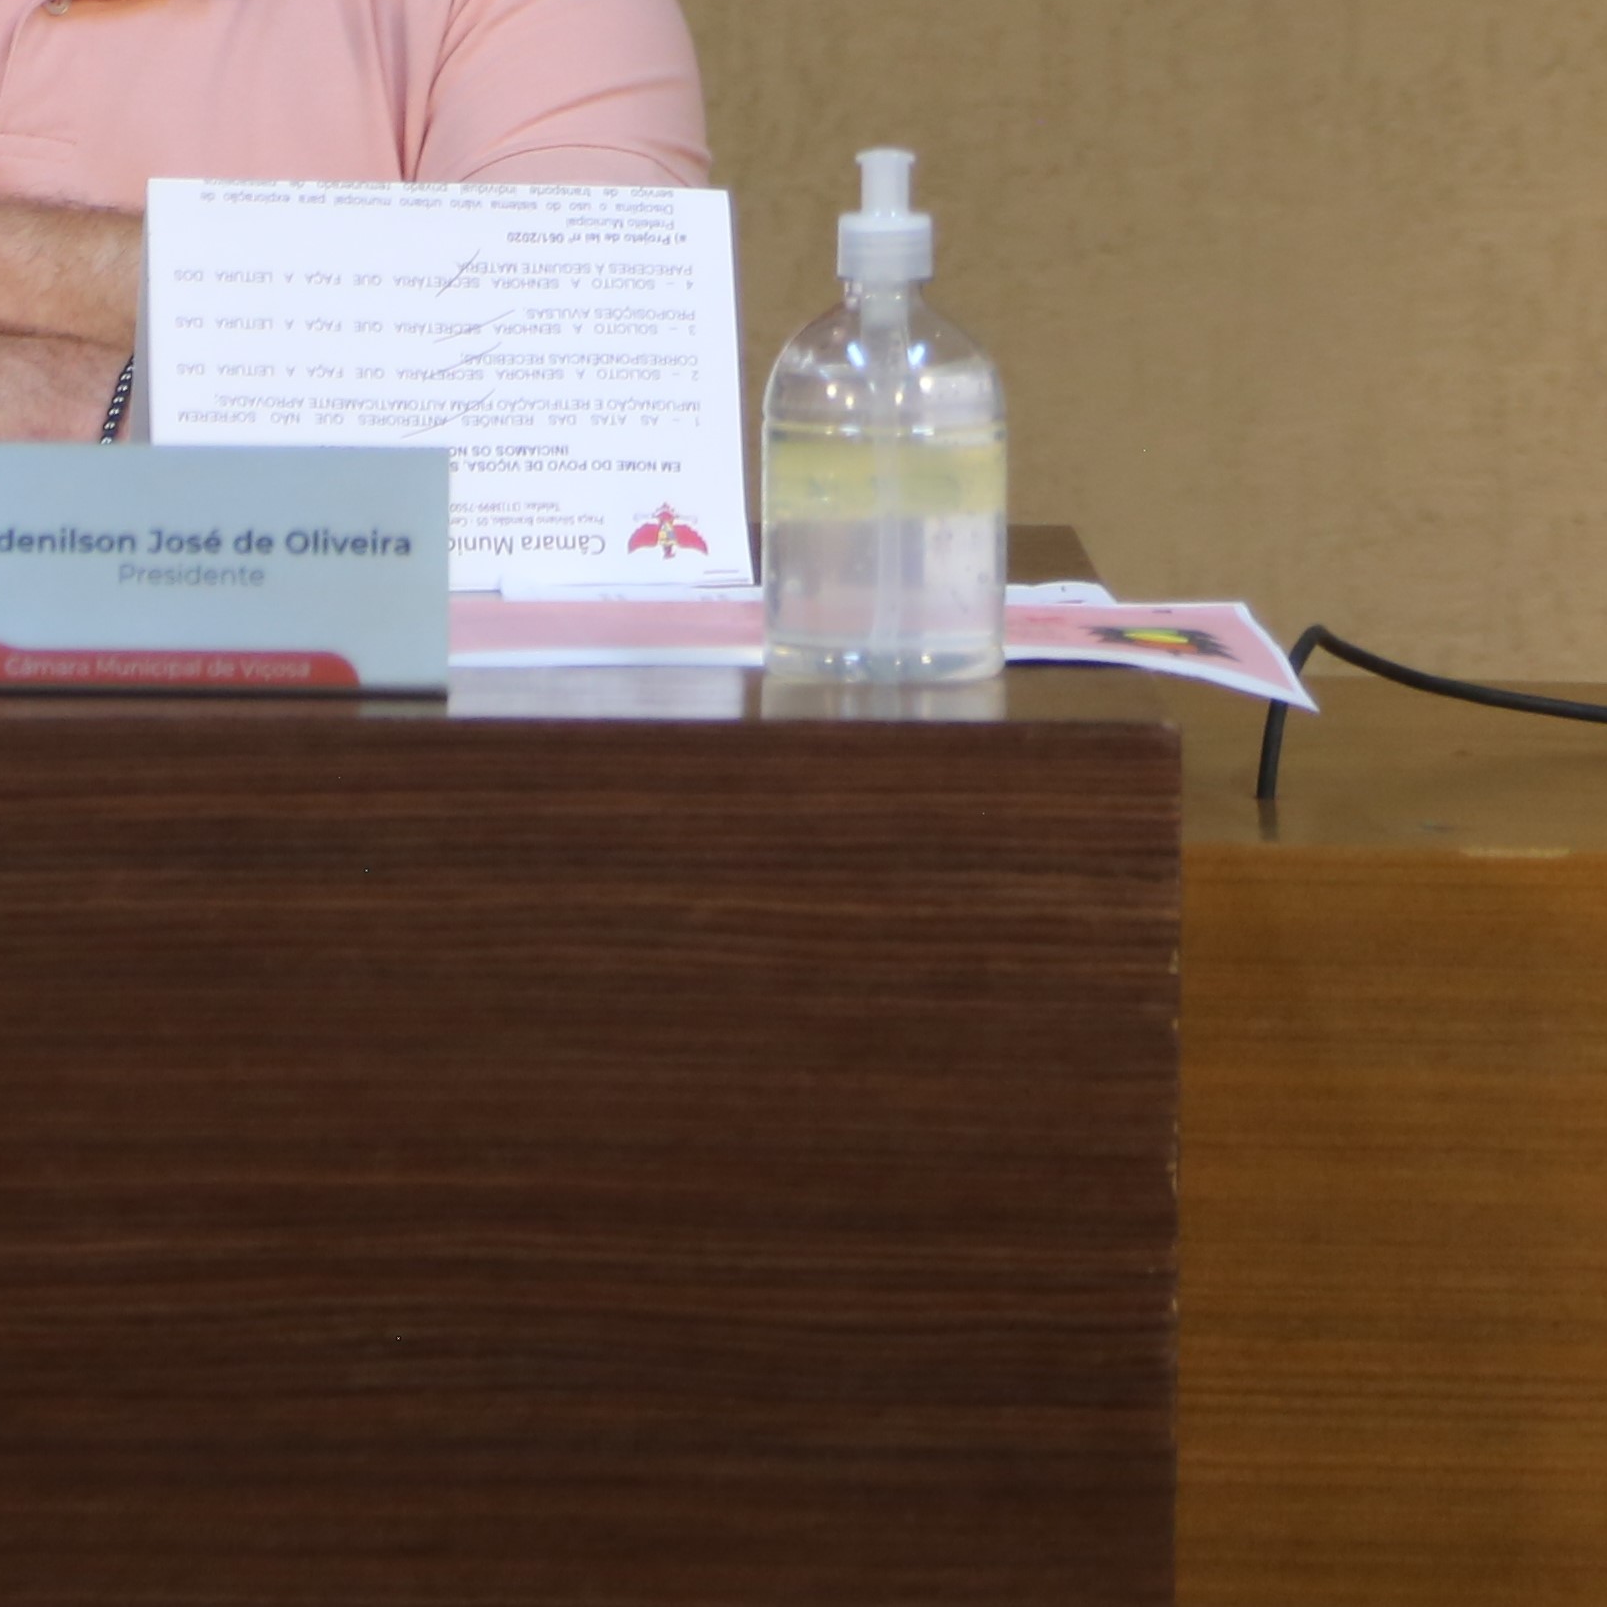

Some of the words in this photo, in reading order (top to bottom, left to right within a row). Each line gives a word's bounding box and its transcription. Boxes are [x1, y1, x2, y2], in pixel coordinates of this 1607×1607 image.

[201, 192, 215, 203] de
[603, 187, 619, 197] de
[298, 193, 325, 205] para
[334, 196, 392, 208] municipal
[399, 197, 442, 208] urbano
[491, 201, 537, 211] sistema
[545, 202, 561, 213] do
[569, 202, 591, 211] uso
[615, 202, 674, 215] Disciplina
[566, 216, 624, 228] Municipal
[627, 218, 674, 229] Prefeito
[585, 233, 600, 244] lei
[605, 233, 620, 244] de
[624, 232, 670, 245] Projeto
[522, 263, 591, 274] SEGUINTE
[608, 263, 692, 275] PARECERES
[174, 270, 203, 282] DOS
[214, 270, 273, 283] LEITURA
[284, 273, 294, 283] A
[304, 271, 341, 286] FAÇA
[353, 274, 382, 286] QUE
[491, 278, 559, 289] SENHORA
[571, 279, 581, 289] A
[591, 278, 655, 289] SOLICITO
[686, 279, 693, 289] 4
[594, 306, 696, 322] PROPOSIÇÕES
[175, 317, 203, 329] DAS
[215, 318, 273, 331] LEITURA
[284, 320, 294, 331] A
[305, 318, 342, 332] FAÇA
[354, 321, 383, 333] QUE
[493, 323, 562, 334] SENHORA
[593, 323, 658, 334] SOLICITO
[573, 324, 583, 334] A
[688, 324, 697, 335] 3
[548, 354, 698, 368] CORRESPONDÊNCIAS
[176, 364, 204, 376] DAS
[216, 365, 274, 377] LEITURA
[286, 366, 295, 377] A
[307, 365, 343, 379] FAÇA
[355, 367, 384, 379] QUE
[495, 369, 564, 380] SENHORA
[576, 369, 585, 380] A
[596, 369, 661, 380] SOLICITO
[691, 370, 699, 381] 2
[308, 397, 446, 410] AUTOMATICAMENTE
[497, 397, 590, 411] RETIFICAÇÃO
[593, 399, 603, 409] E
[607, 397, 701, 412] IMPUGNAÇÃO
[177, 411, 255, 423] SOFREREM
[270, 413, 300, 425] NÃO
[315, 413, 344, 425] QUE
[358, 414, 447, 427] ANTERIORES
[461, 414, 534, 427] REUNIÕES
[548, 415, 577, 425] DAS
[591, 415, 627, 426] ATAS
[640, 415, 659, 425] AS
[694, 417, 701, 427] 1
[472, 445, 491, 456] OS
[496, 445, 568, 456] INICIAMOS
[525, 460, 543, 471] DE
[548, 459, 587, 471] POVO
[591, 460, 612, 471] DO
[617, 460, 657, 471] NOME
[660, 461, 681, 472] EM
[147, 528, 221, 555] José
[233, 530, 273, 555] de
[285, 529, 412, 557] Oliveira
[521, 534, 606, 557] Câmara
[119, 564, 265, 587] Presidente
